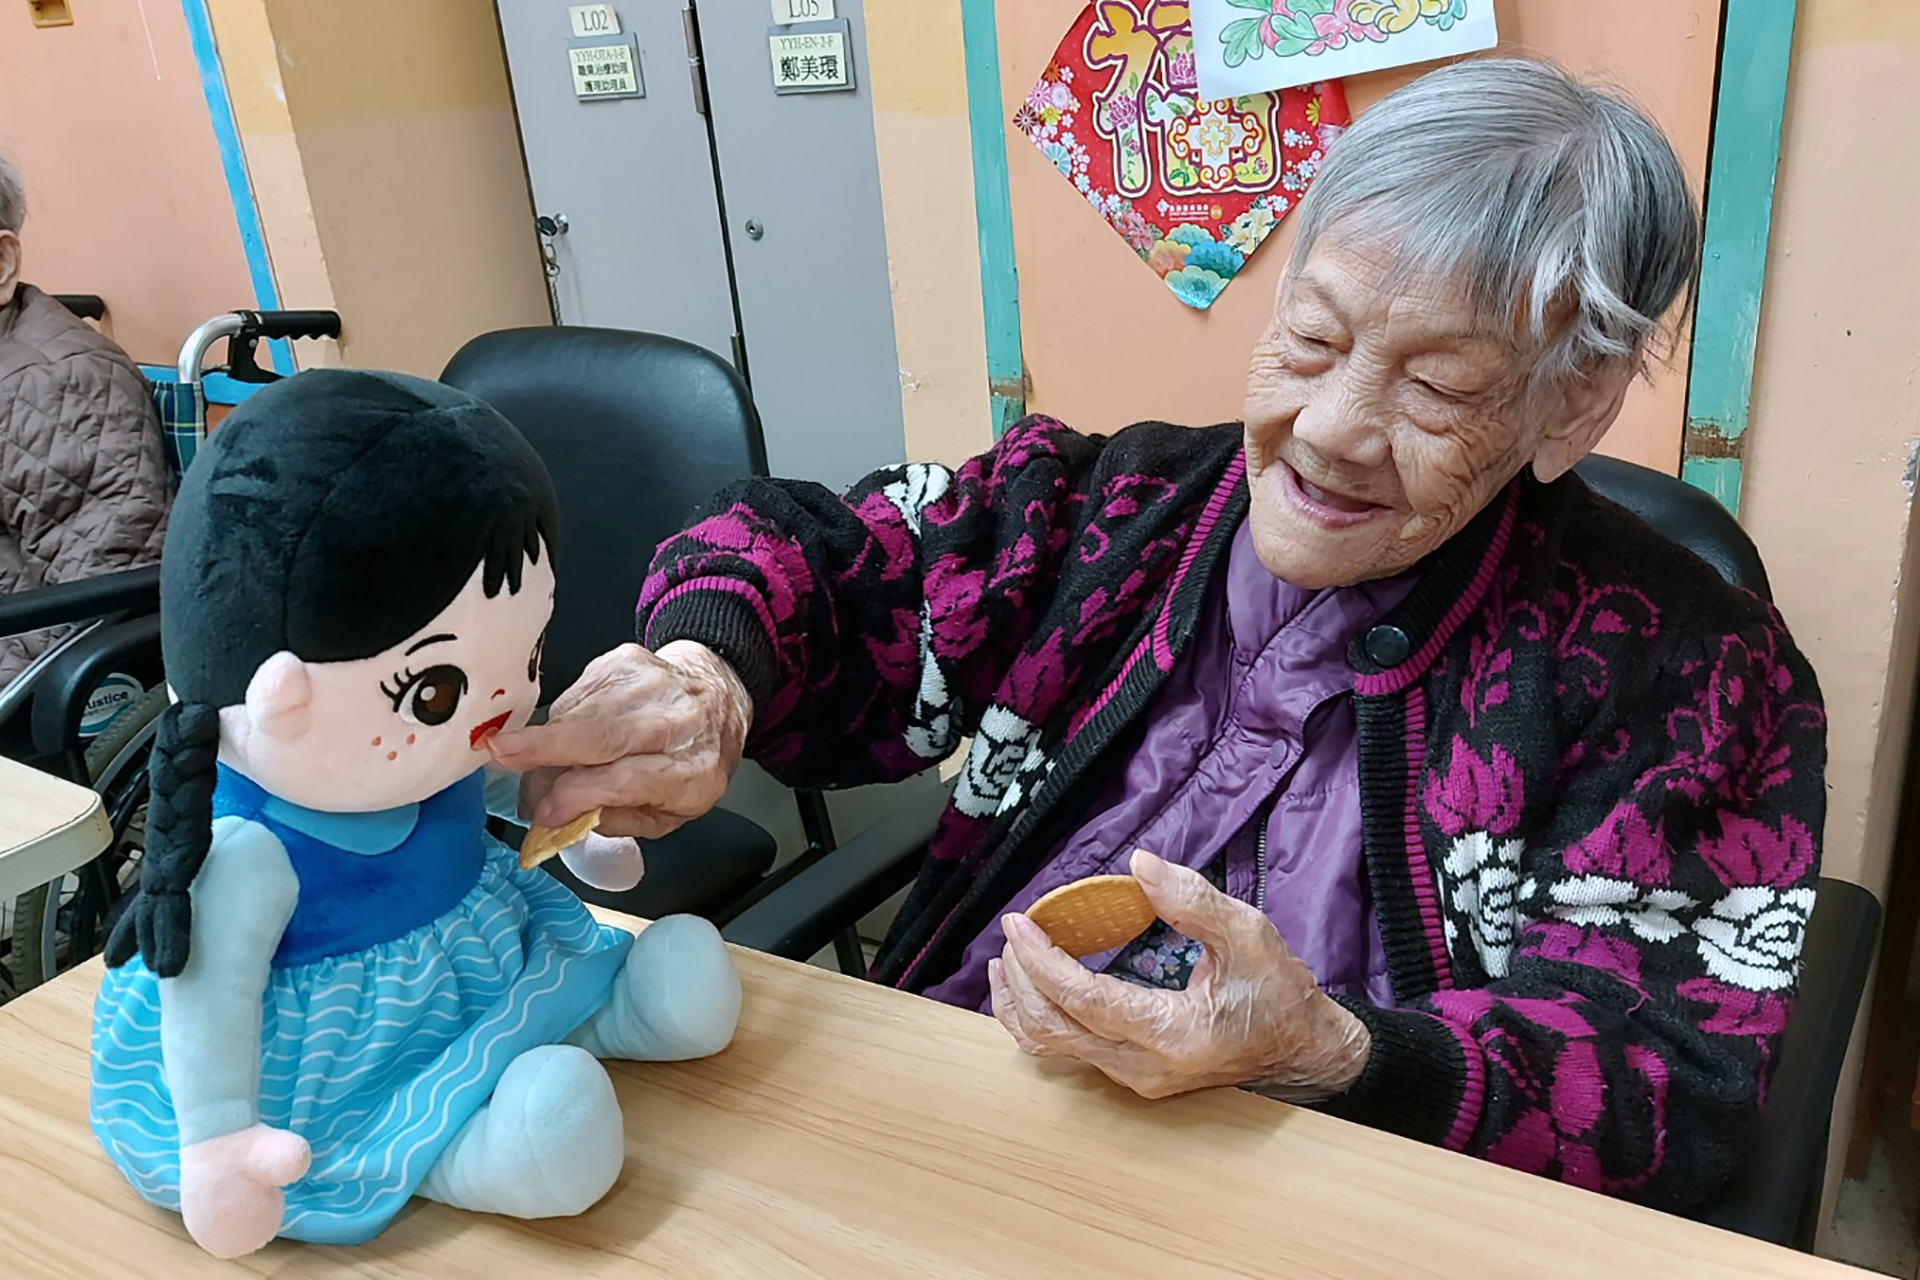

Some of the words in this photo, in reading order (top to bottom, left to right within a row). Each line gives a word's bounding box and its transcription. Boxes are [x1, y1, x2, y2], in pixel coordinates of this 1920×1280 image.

[789, 0, 819, 18] L05
[580, 9, 609, 31] L02
[779, 35, 834, 50] YYH-EN-2-F
[779, 54, 840, 82] 鄭美環
[86, 691, 129, 710] ustice
